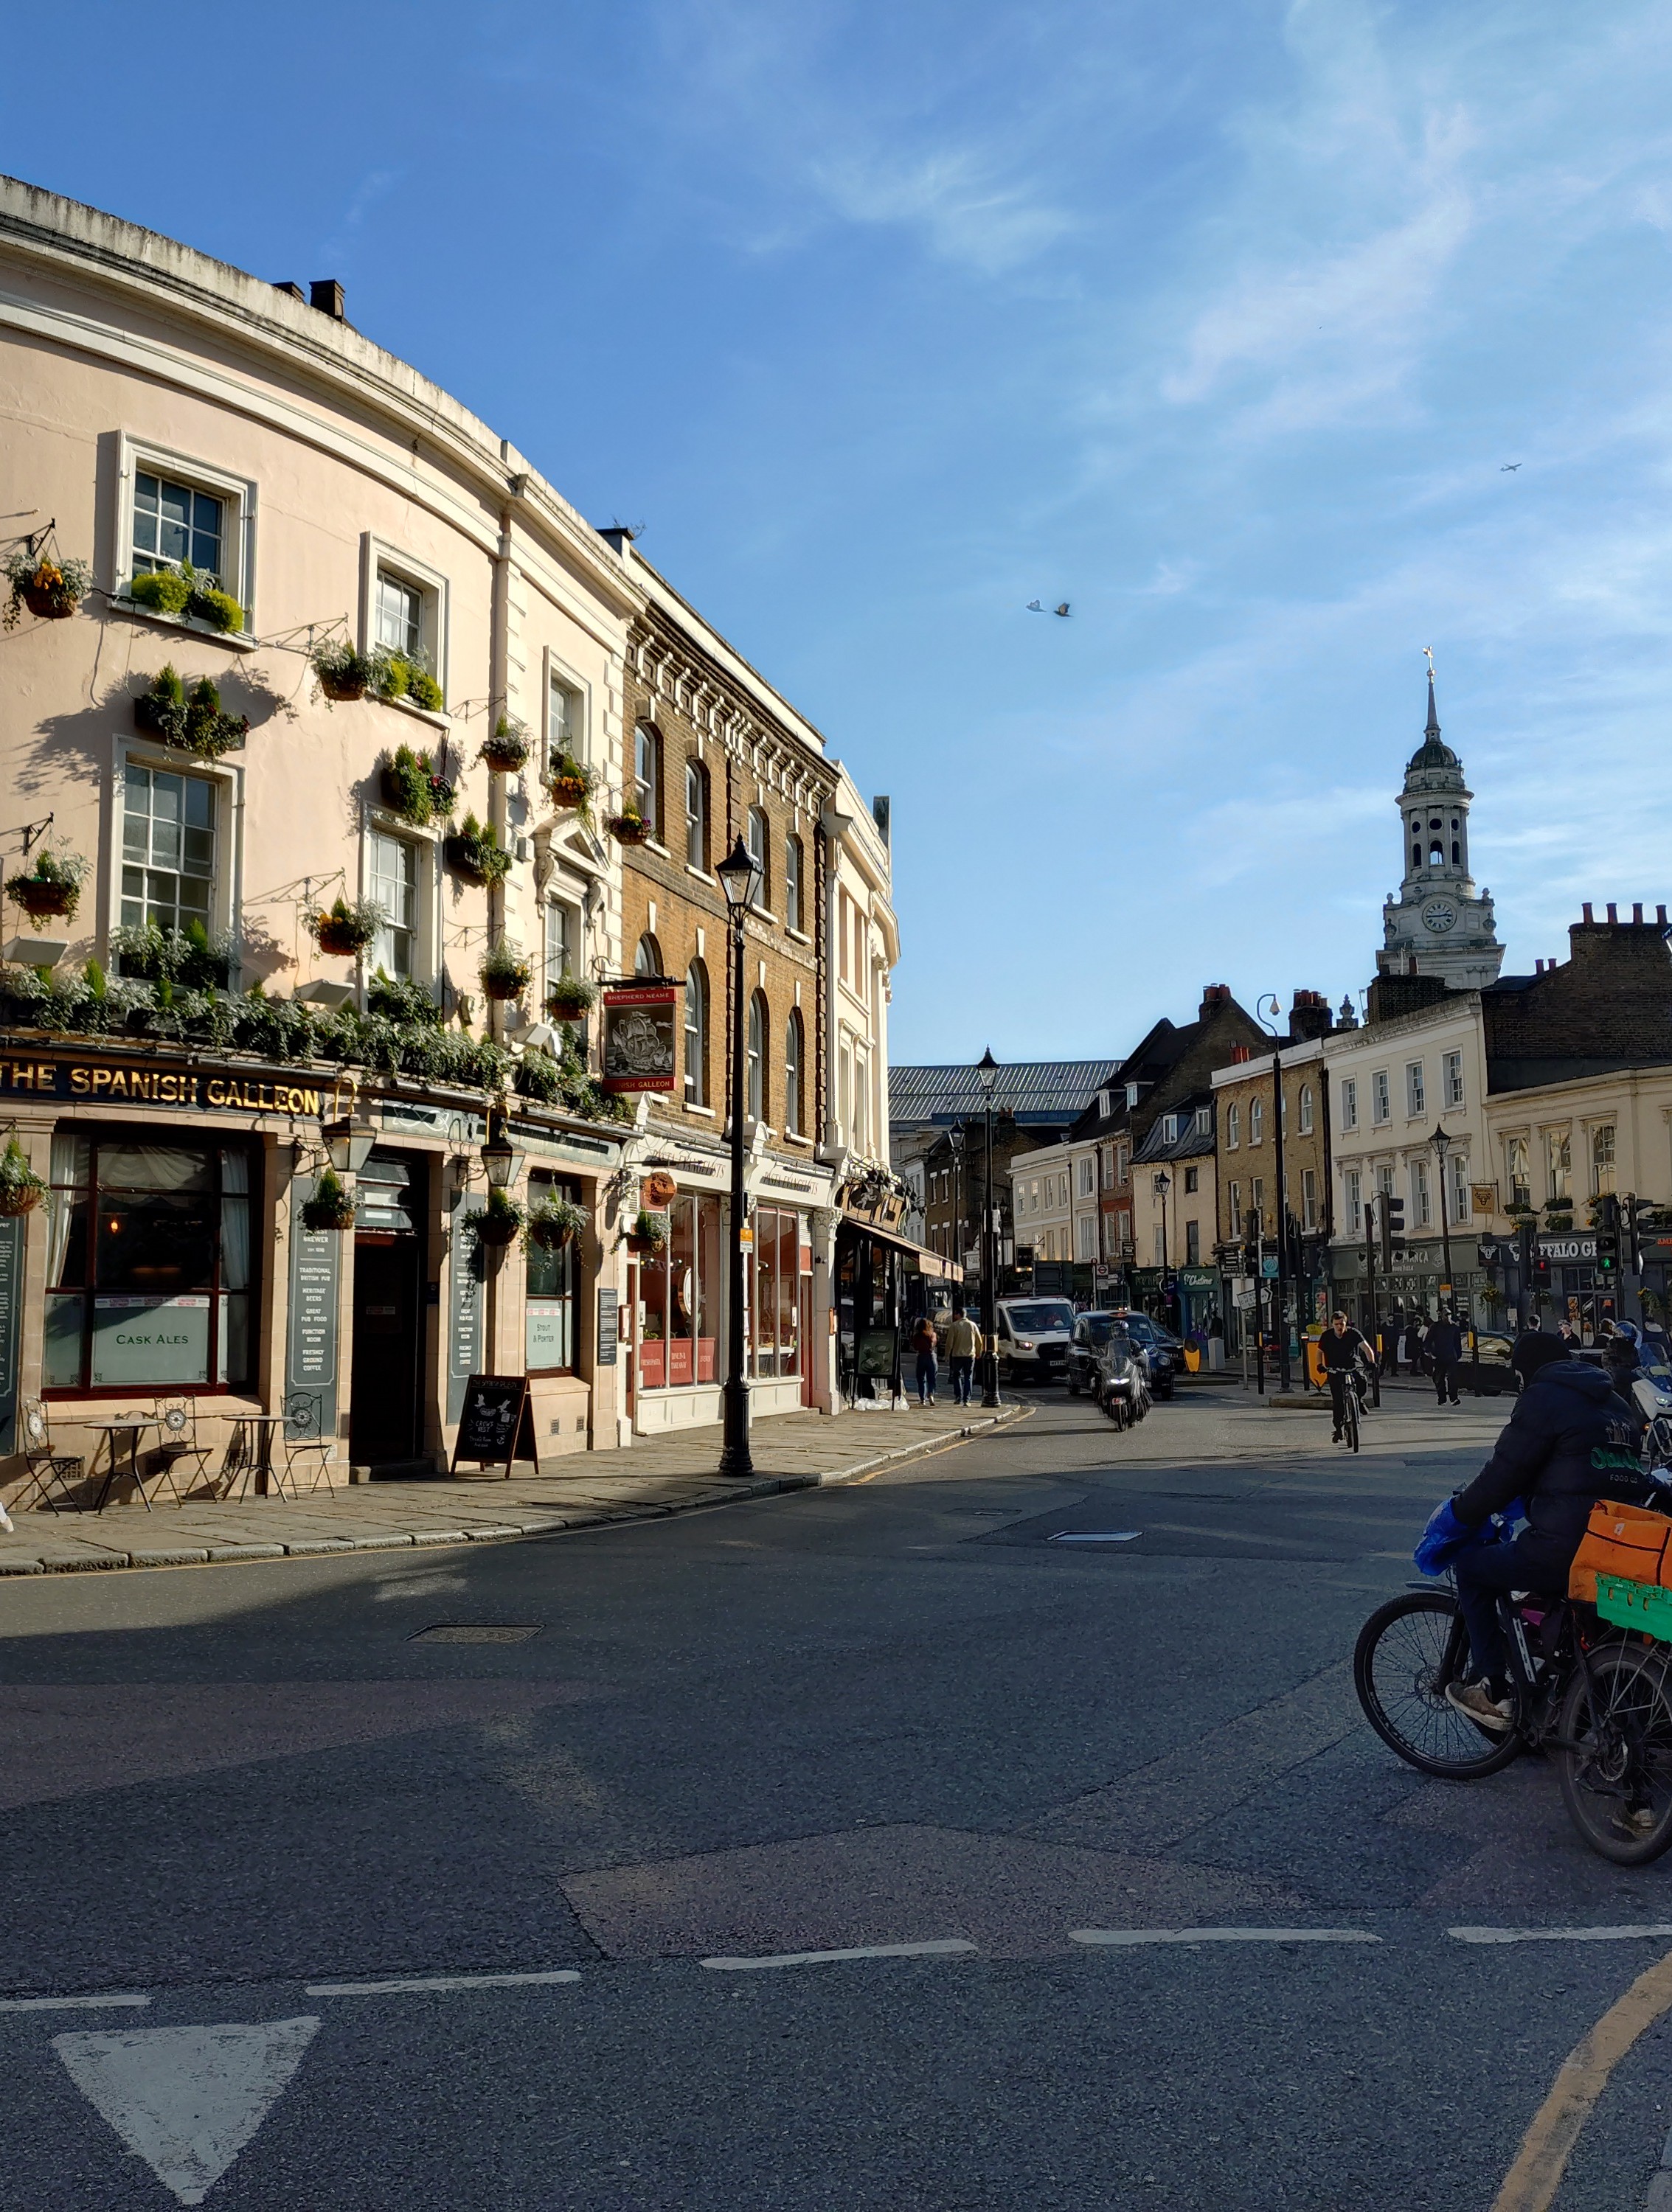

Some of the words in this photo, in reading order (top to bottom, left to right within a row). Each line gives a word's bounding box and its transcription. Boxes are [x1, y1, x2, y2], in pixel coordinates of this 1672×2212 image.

[0, 1061, 57, 1091] THE
[70, 1068, 198, 1104] SPANISH
[207, 1079, 319, 1115] GALLEON
[638, 1080, 670, 1088] GALLEON
[1530, 1242, 1579, 1258] FFALO
[1609, 1475, 1628, 1483] FOOD
